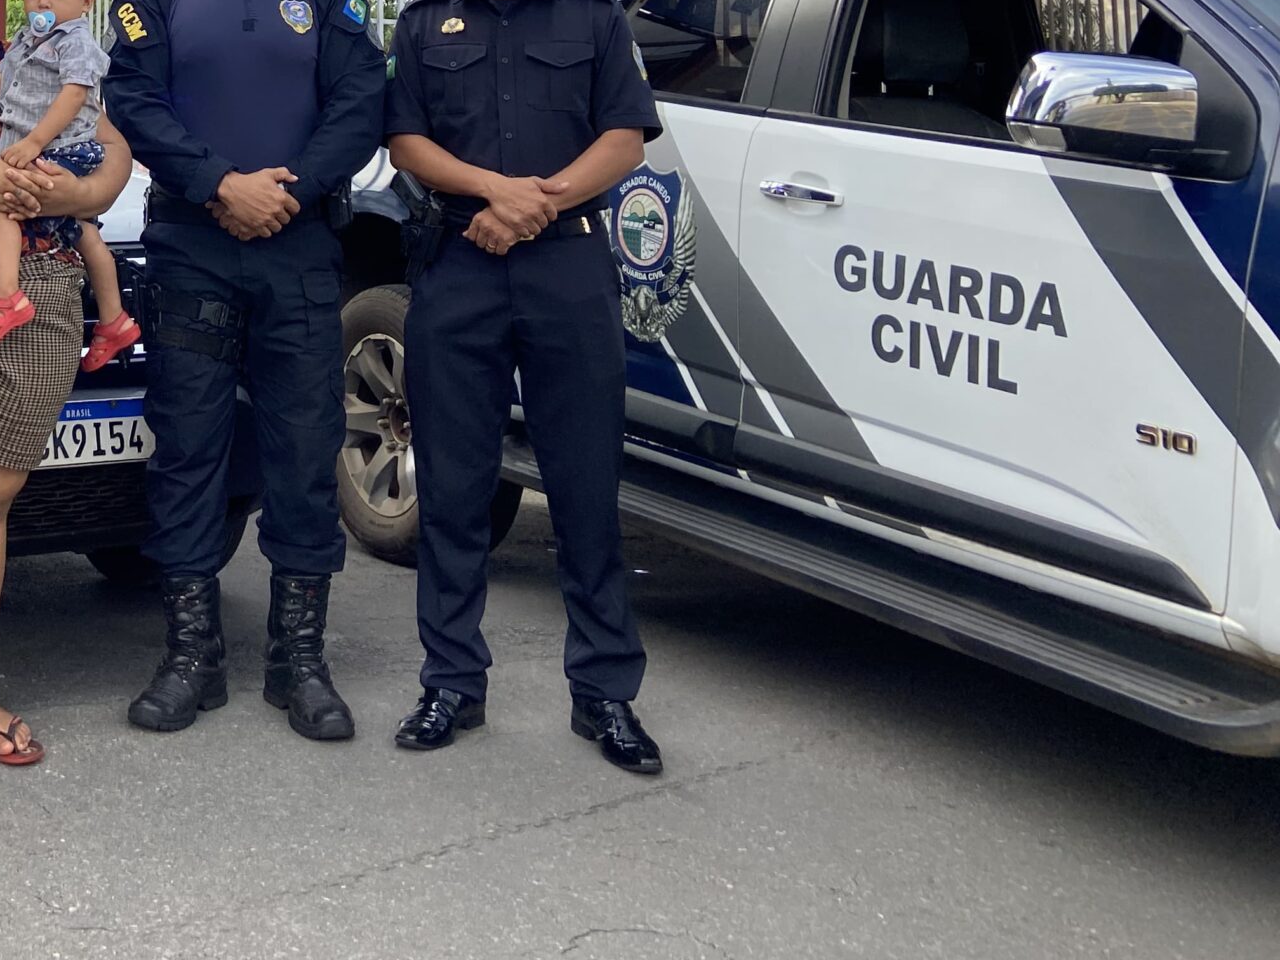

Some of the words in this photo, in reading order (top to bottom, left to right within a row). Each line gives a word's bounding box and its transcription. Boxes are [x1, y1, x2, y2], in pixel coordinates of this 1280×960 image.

[117, 3, 148, 42] GCM
[619, 175, 648, 195] SENADOR
[648, 177, 671, 204] CANEDO
[622, 264, 648, 281] GUARDA
[648, 270, 666, 281] CIVIL
[833, 244, 1068, 339] GUARDA
[871, 313, 1019, 395] CIVIL
[65, 409, 92, 419] BRASIL
[1135, 422, 1198, 456] S10
